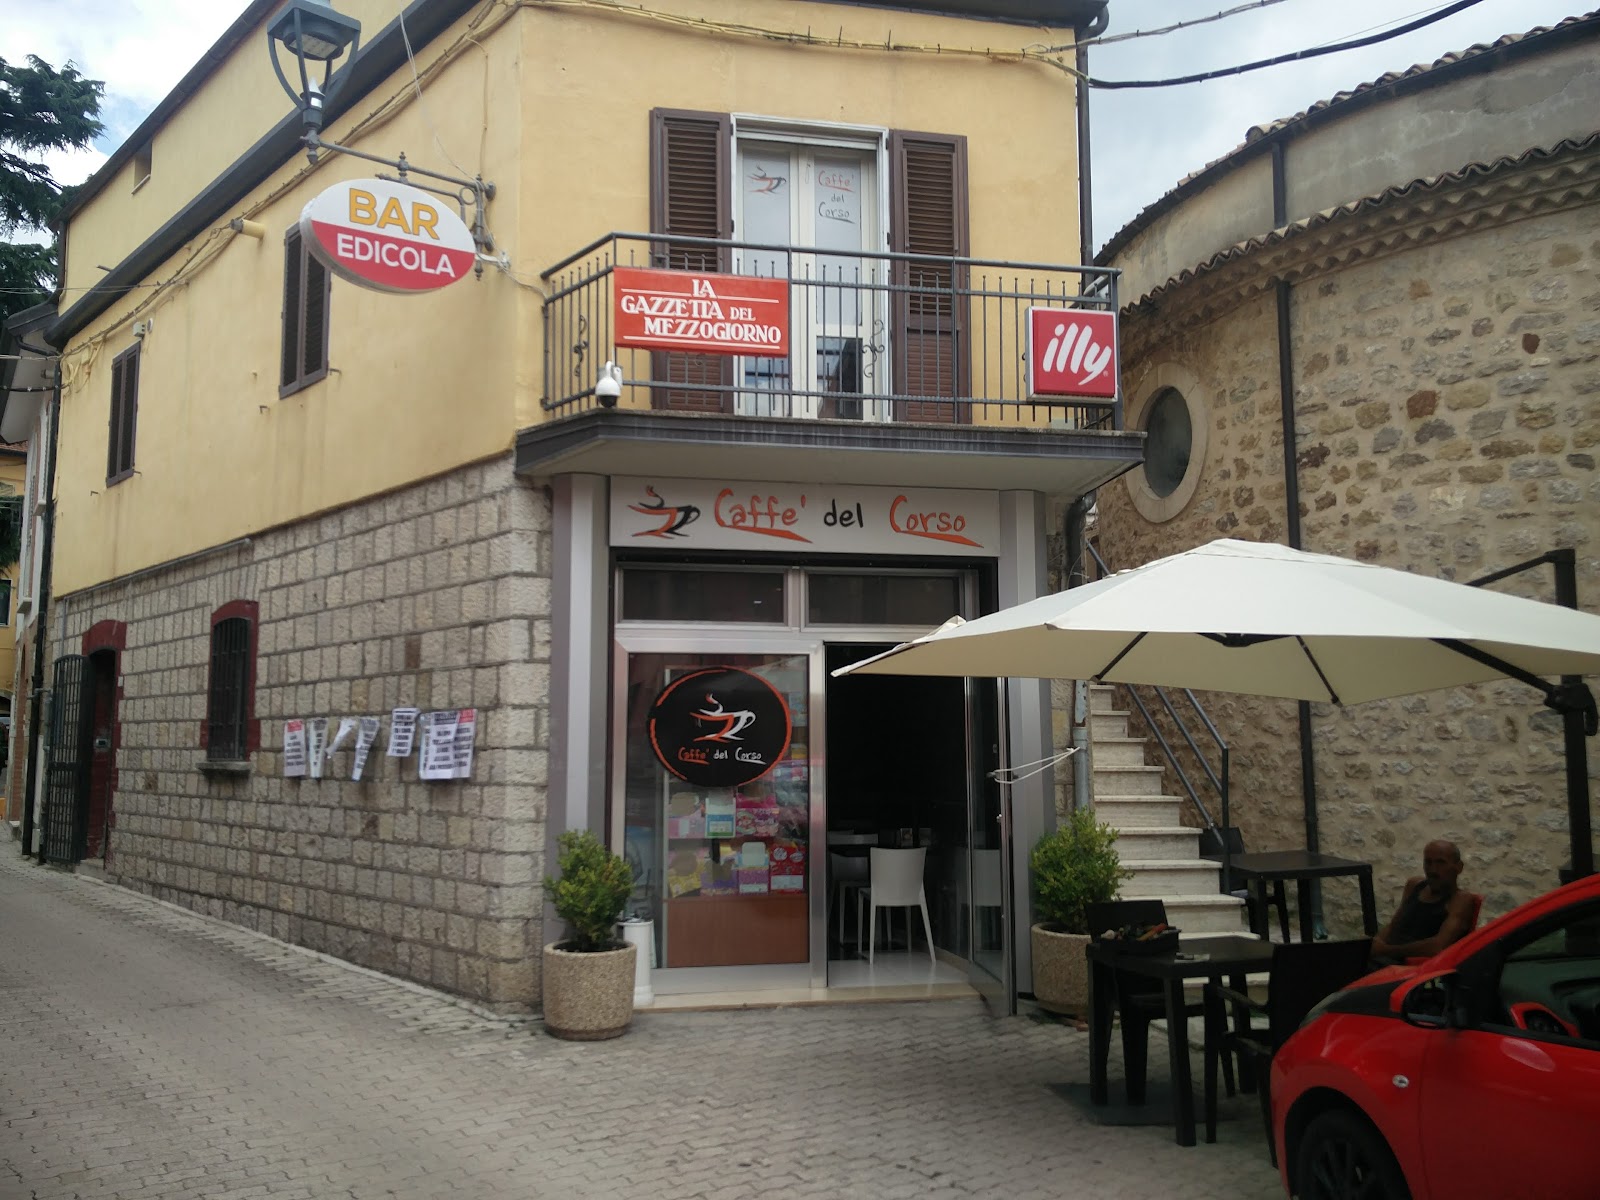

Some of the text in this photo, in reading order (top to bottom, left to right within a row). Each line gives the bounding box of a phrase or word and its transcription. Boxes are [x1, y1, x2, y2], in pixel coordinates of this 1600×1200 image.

[348, 187, 440, 240] BAR
[818, 201, 851, 219] Corso
[336, 232, 456, 279] EDICOLA
[691, 279, 718, 299] LA
[620, 295, 757, 322] GAZZETTA DEL
[643, 316, 782, 344] MEZZOGIORNO
[1042, 321, 1113, 386] illy
[823, 498, 864, 528] del
[890, 494, 970, 539] Corso
[713, 749, 729, 760] del
[734, 746, 763, 762] Corso
